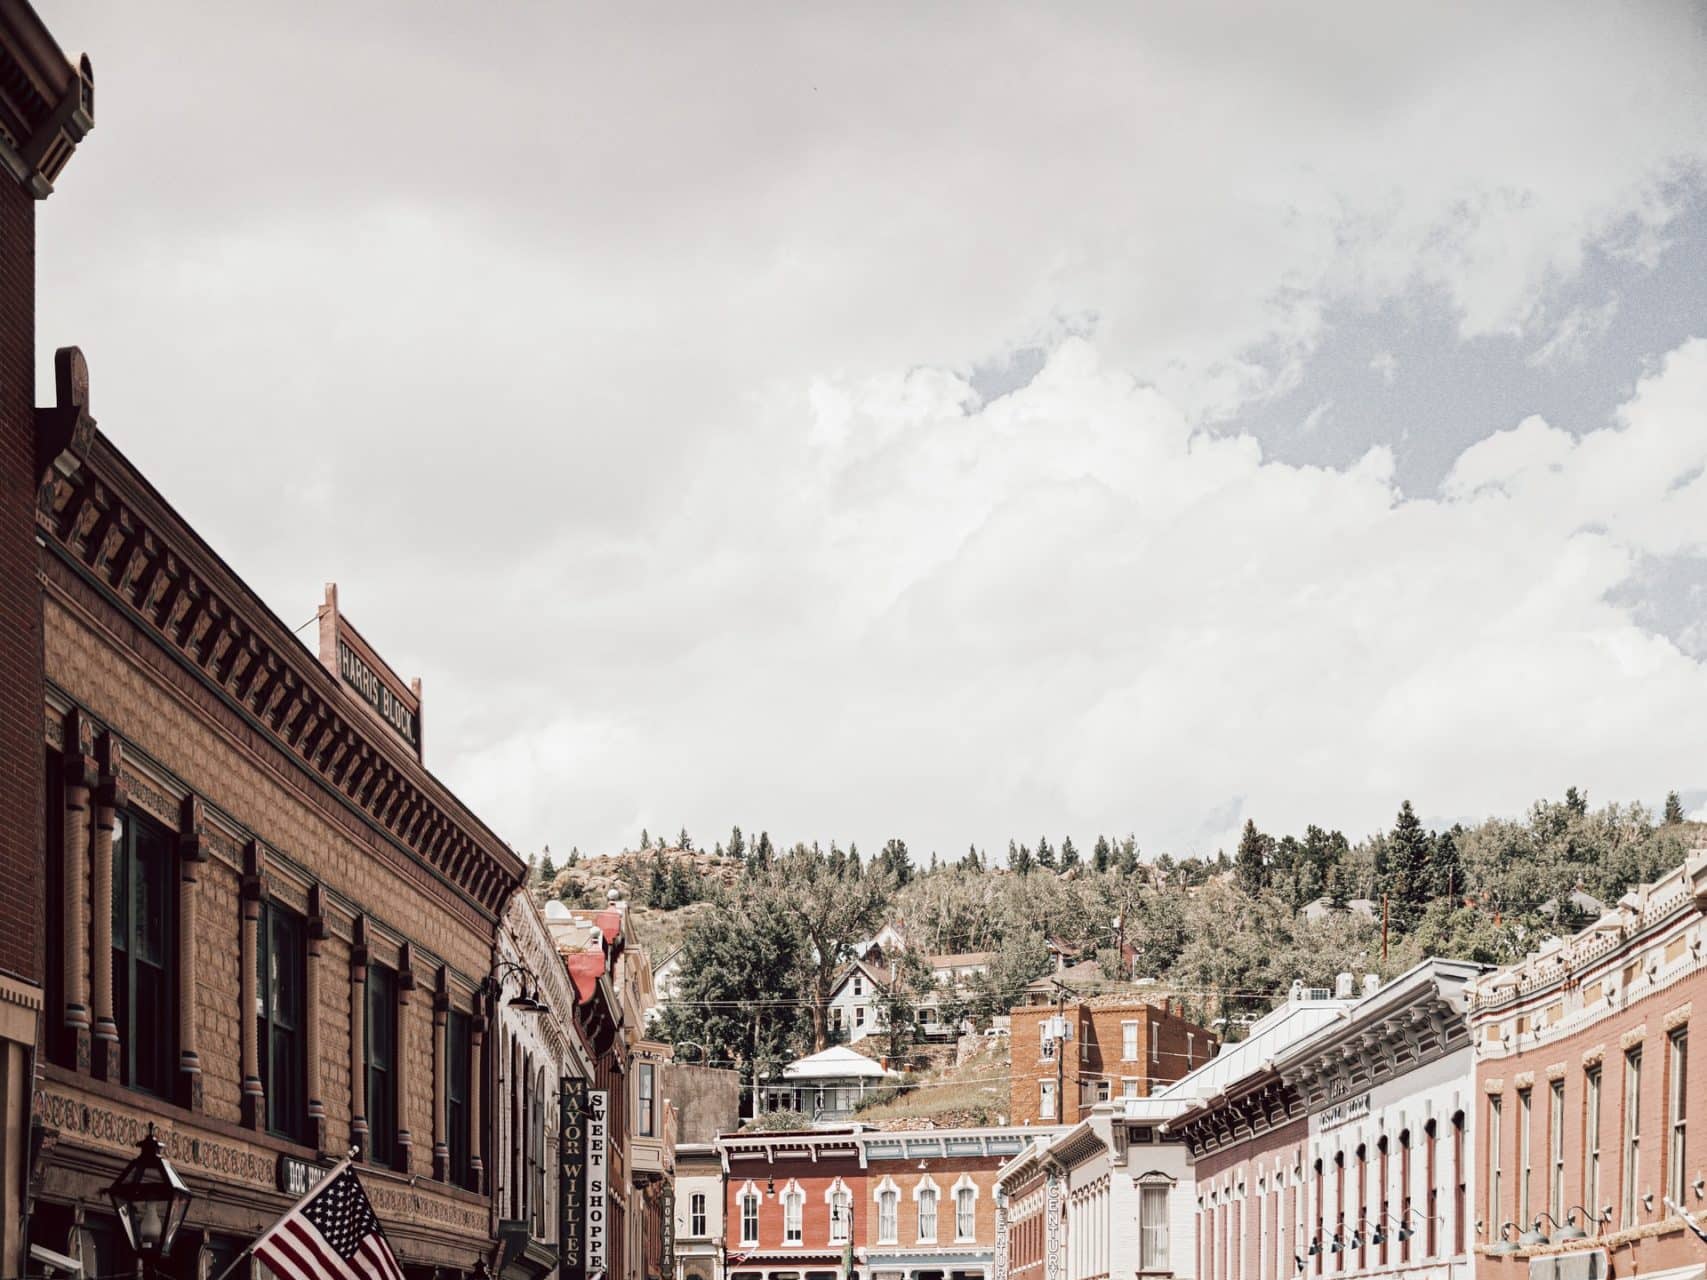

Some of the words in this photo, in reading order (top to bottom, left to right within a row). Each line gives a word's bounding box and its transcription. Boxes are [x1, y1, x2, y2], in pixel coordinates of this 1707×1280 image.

[342, 643, 379, 706] HARRIS
[564, 1082, 583, 1154] MAYOR
[591, 1094, 606, 1166] SWEET
[289, 1161, 306, 1193] DOC
[563, 1164, 583, 1266] WILLIES
[590, 1180, 603, 1268] SHOPPE
[663, 1197, 671, 1265] BONANZA
